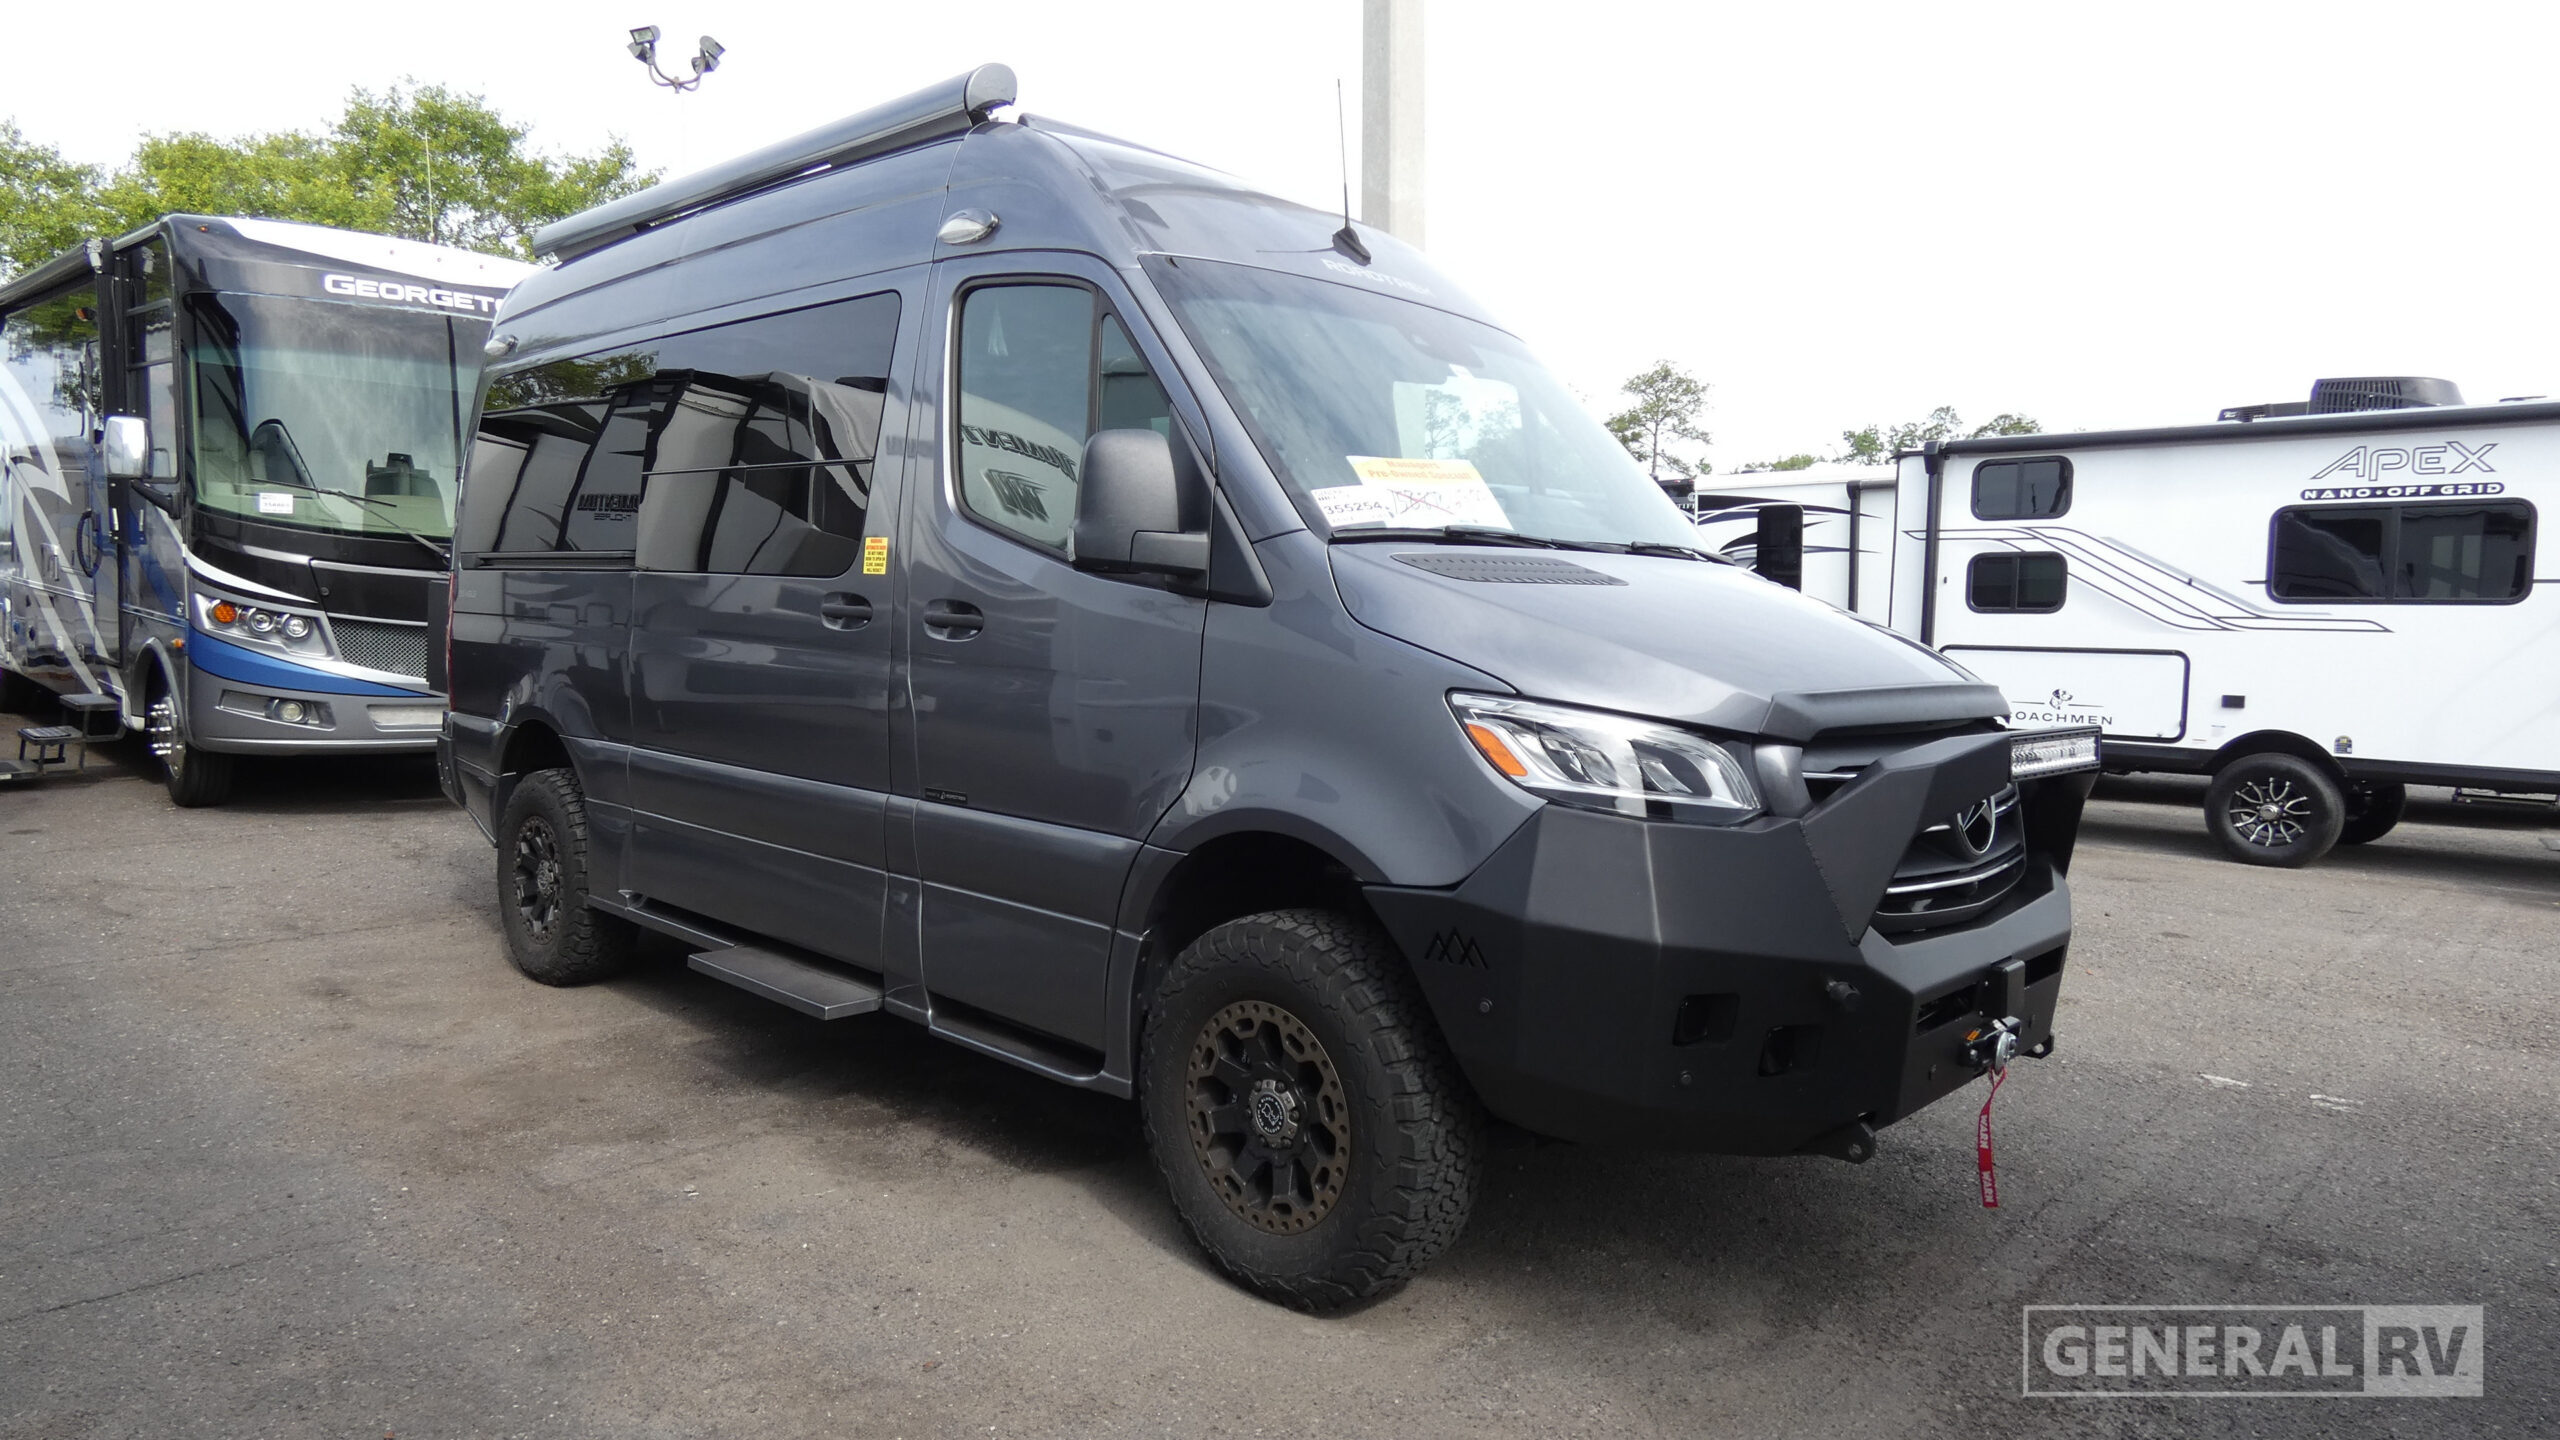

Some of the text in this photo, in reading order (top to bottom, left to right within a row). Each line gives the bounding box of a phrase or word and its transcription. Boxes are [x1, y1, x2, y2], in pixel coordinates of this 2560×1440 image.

[1320, 258, 1437, 298] ROADTREK
[2310, 441, 2499, 481] APEX
[2440, 483, 2502, 494] GRID
[1323, 501, 1382, 515] 355254
[2011, 711, 2113, 725] OACHMEN
[1979, 1114, 1989, 1149] WARN
[1981, 1170, 1995, 1203] WARN
